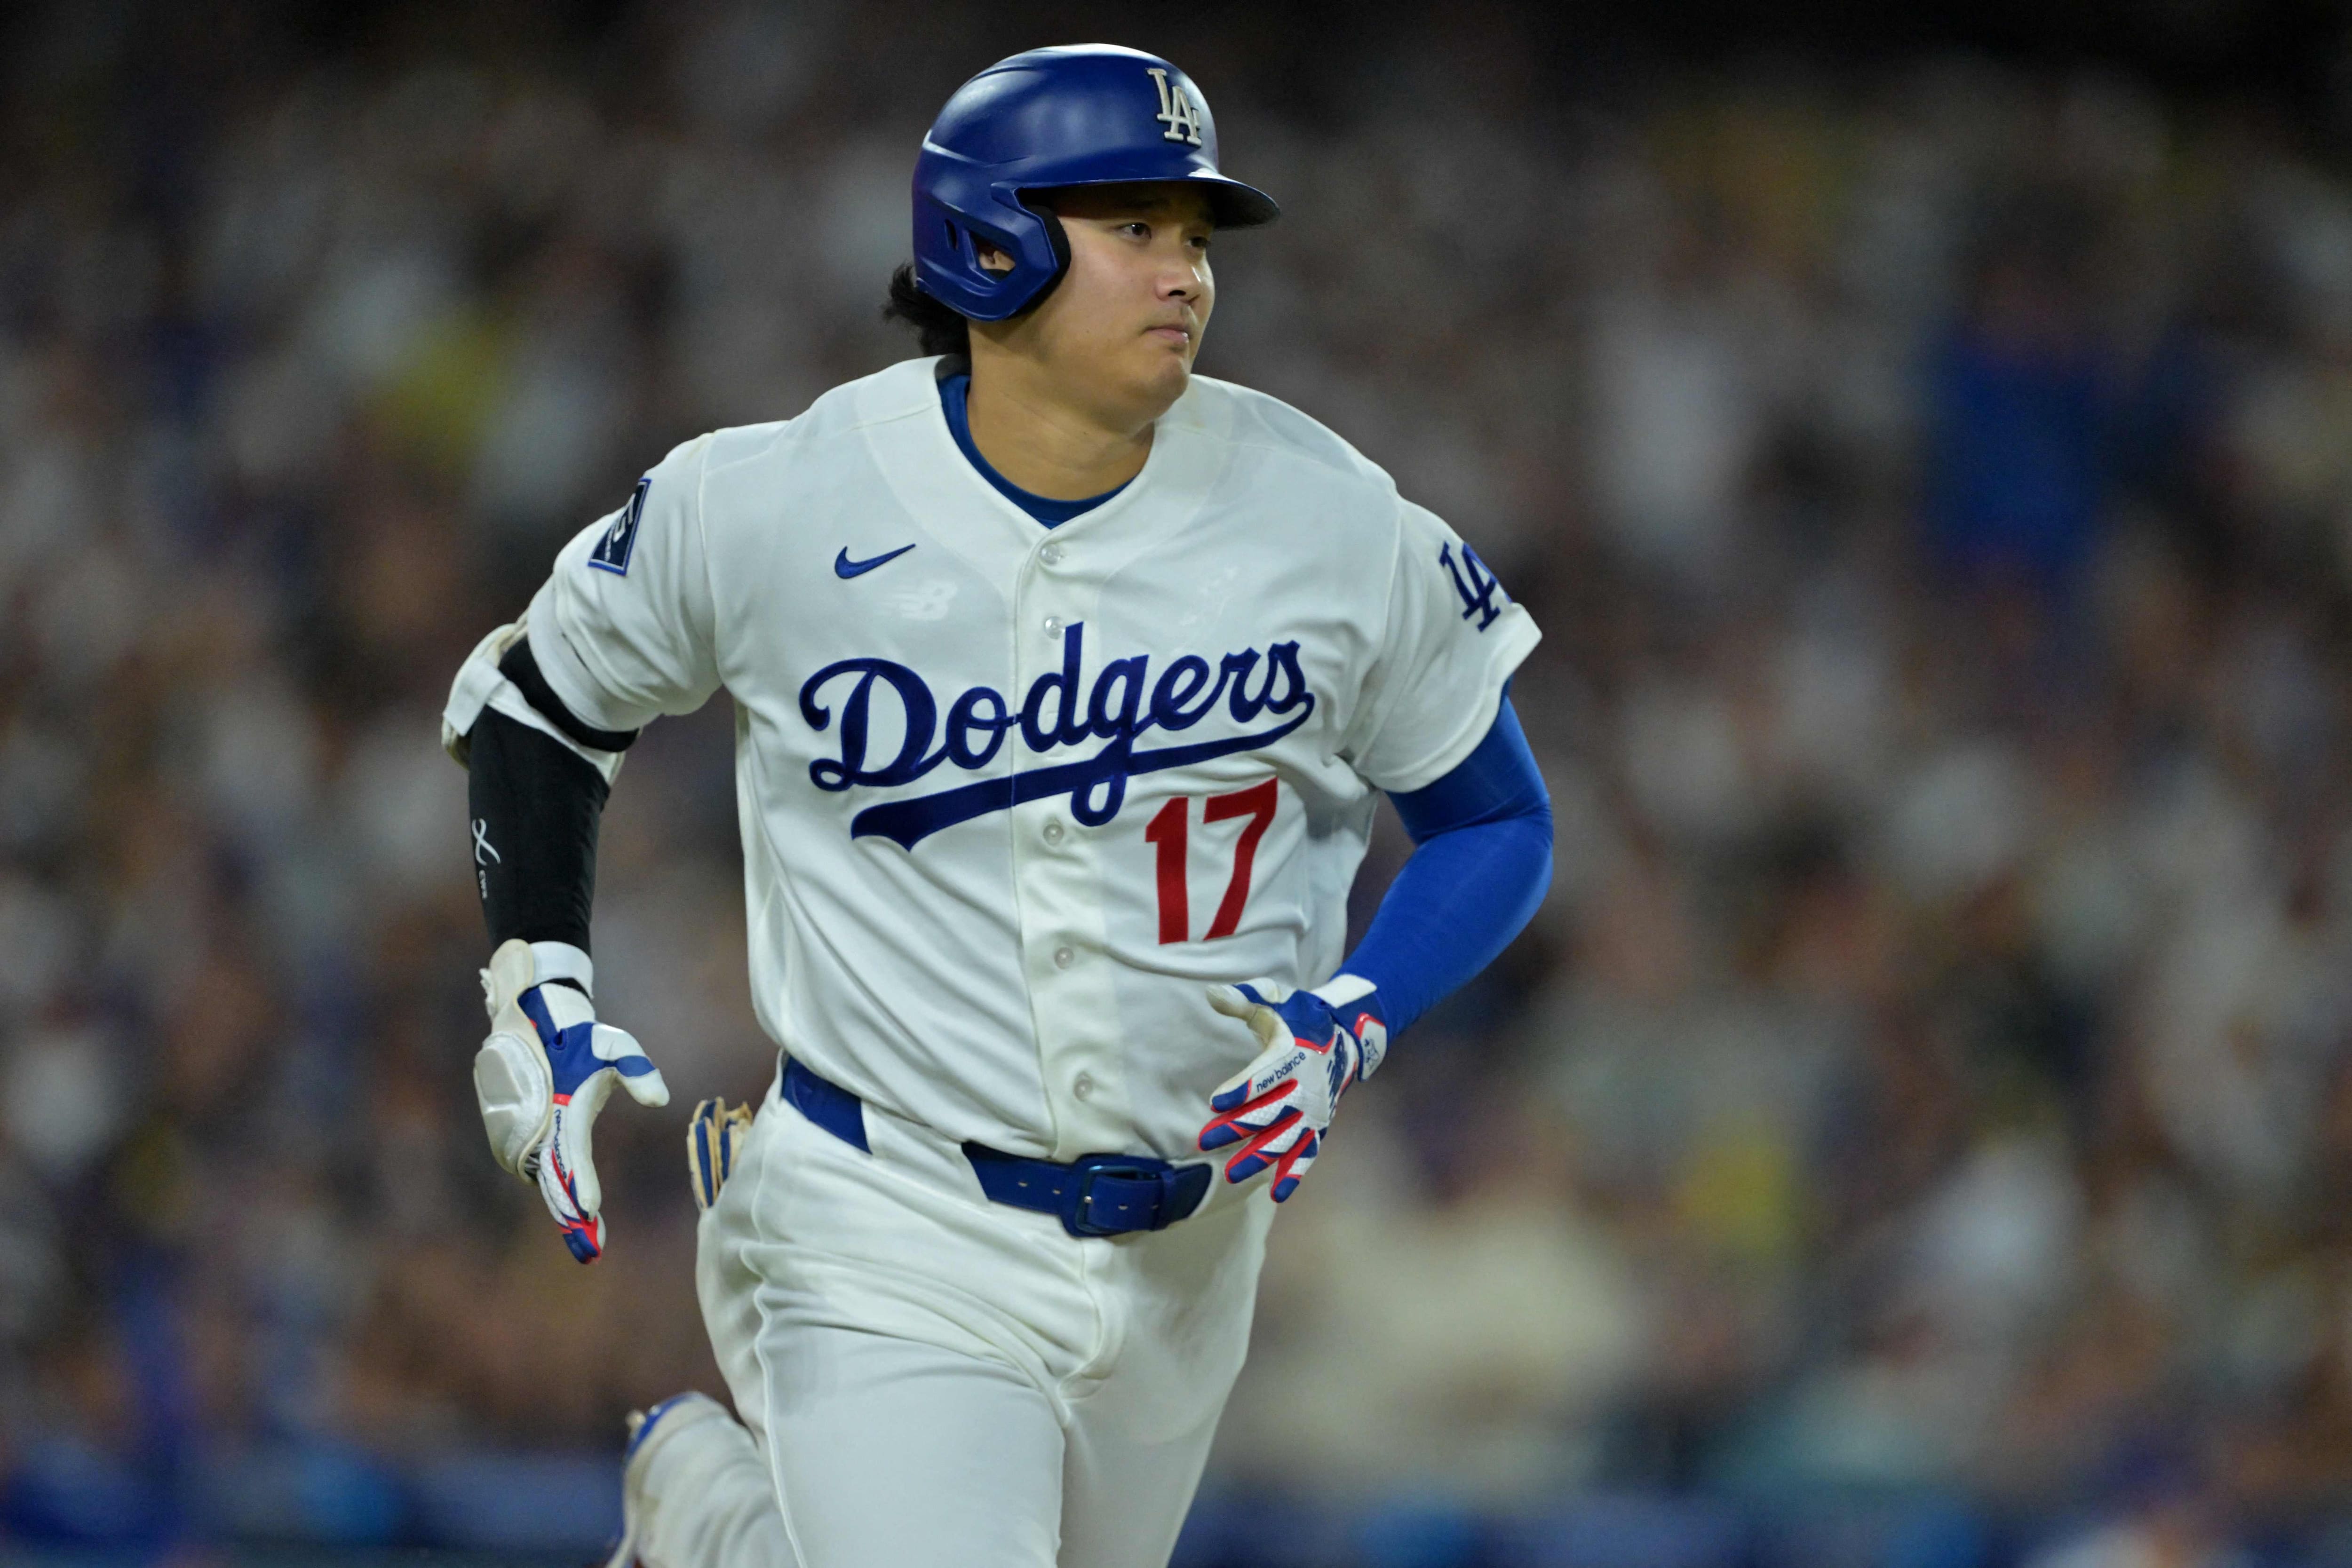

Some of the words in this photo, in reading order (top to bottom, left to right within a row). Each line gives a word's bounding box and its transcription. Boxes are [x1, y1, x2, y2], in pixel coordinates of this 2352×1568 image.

[1147, 68, 1201, 147] LA
[1439, 541, 1512, 633] LA
[799, 621, 1314, 826] Dodgers
[1145, 777, 1278, 945] 17
[1256, 1075, 1274, 1092] new
